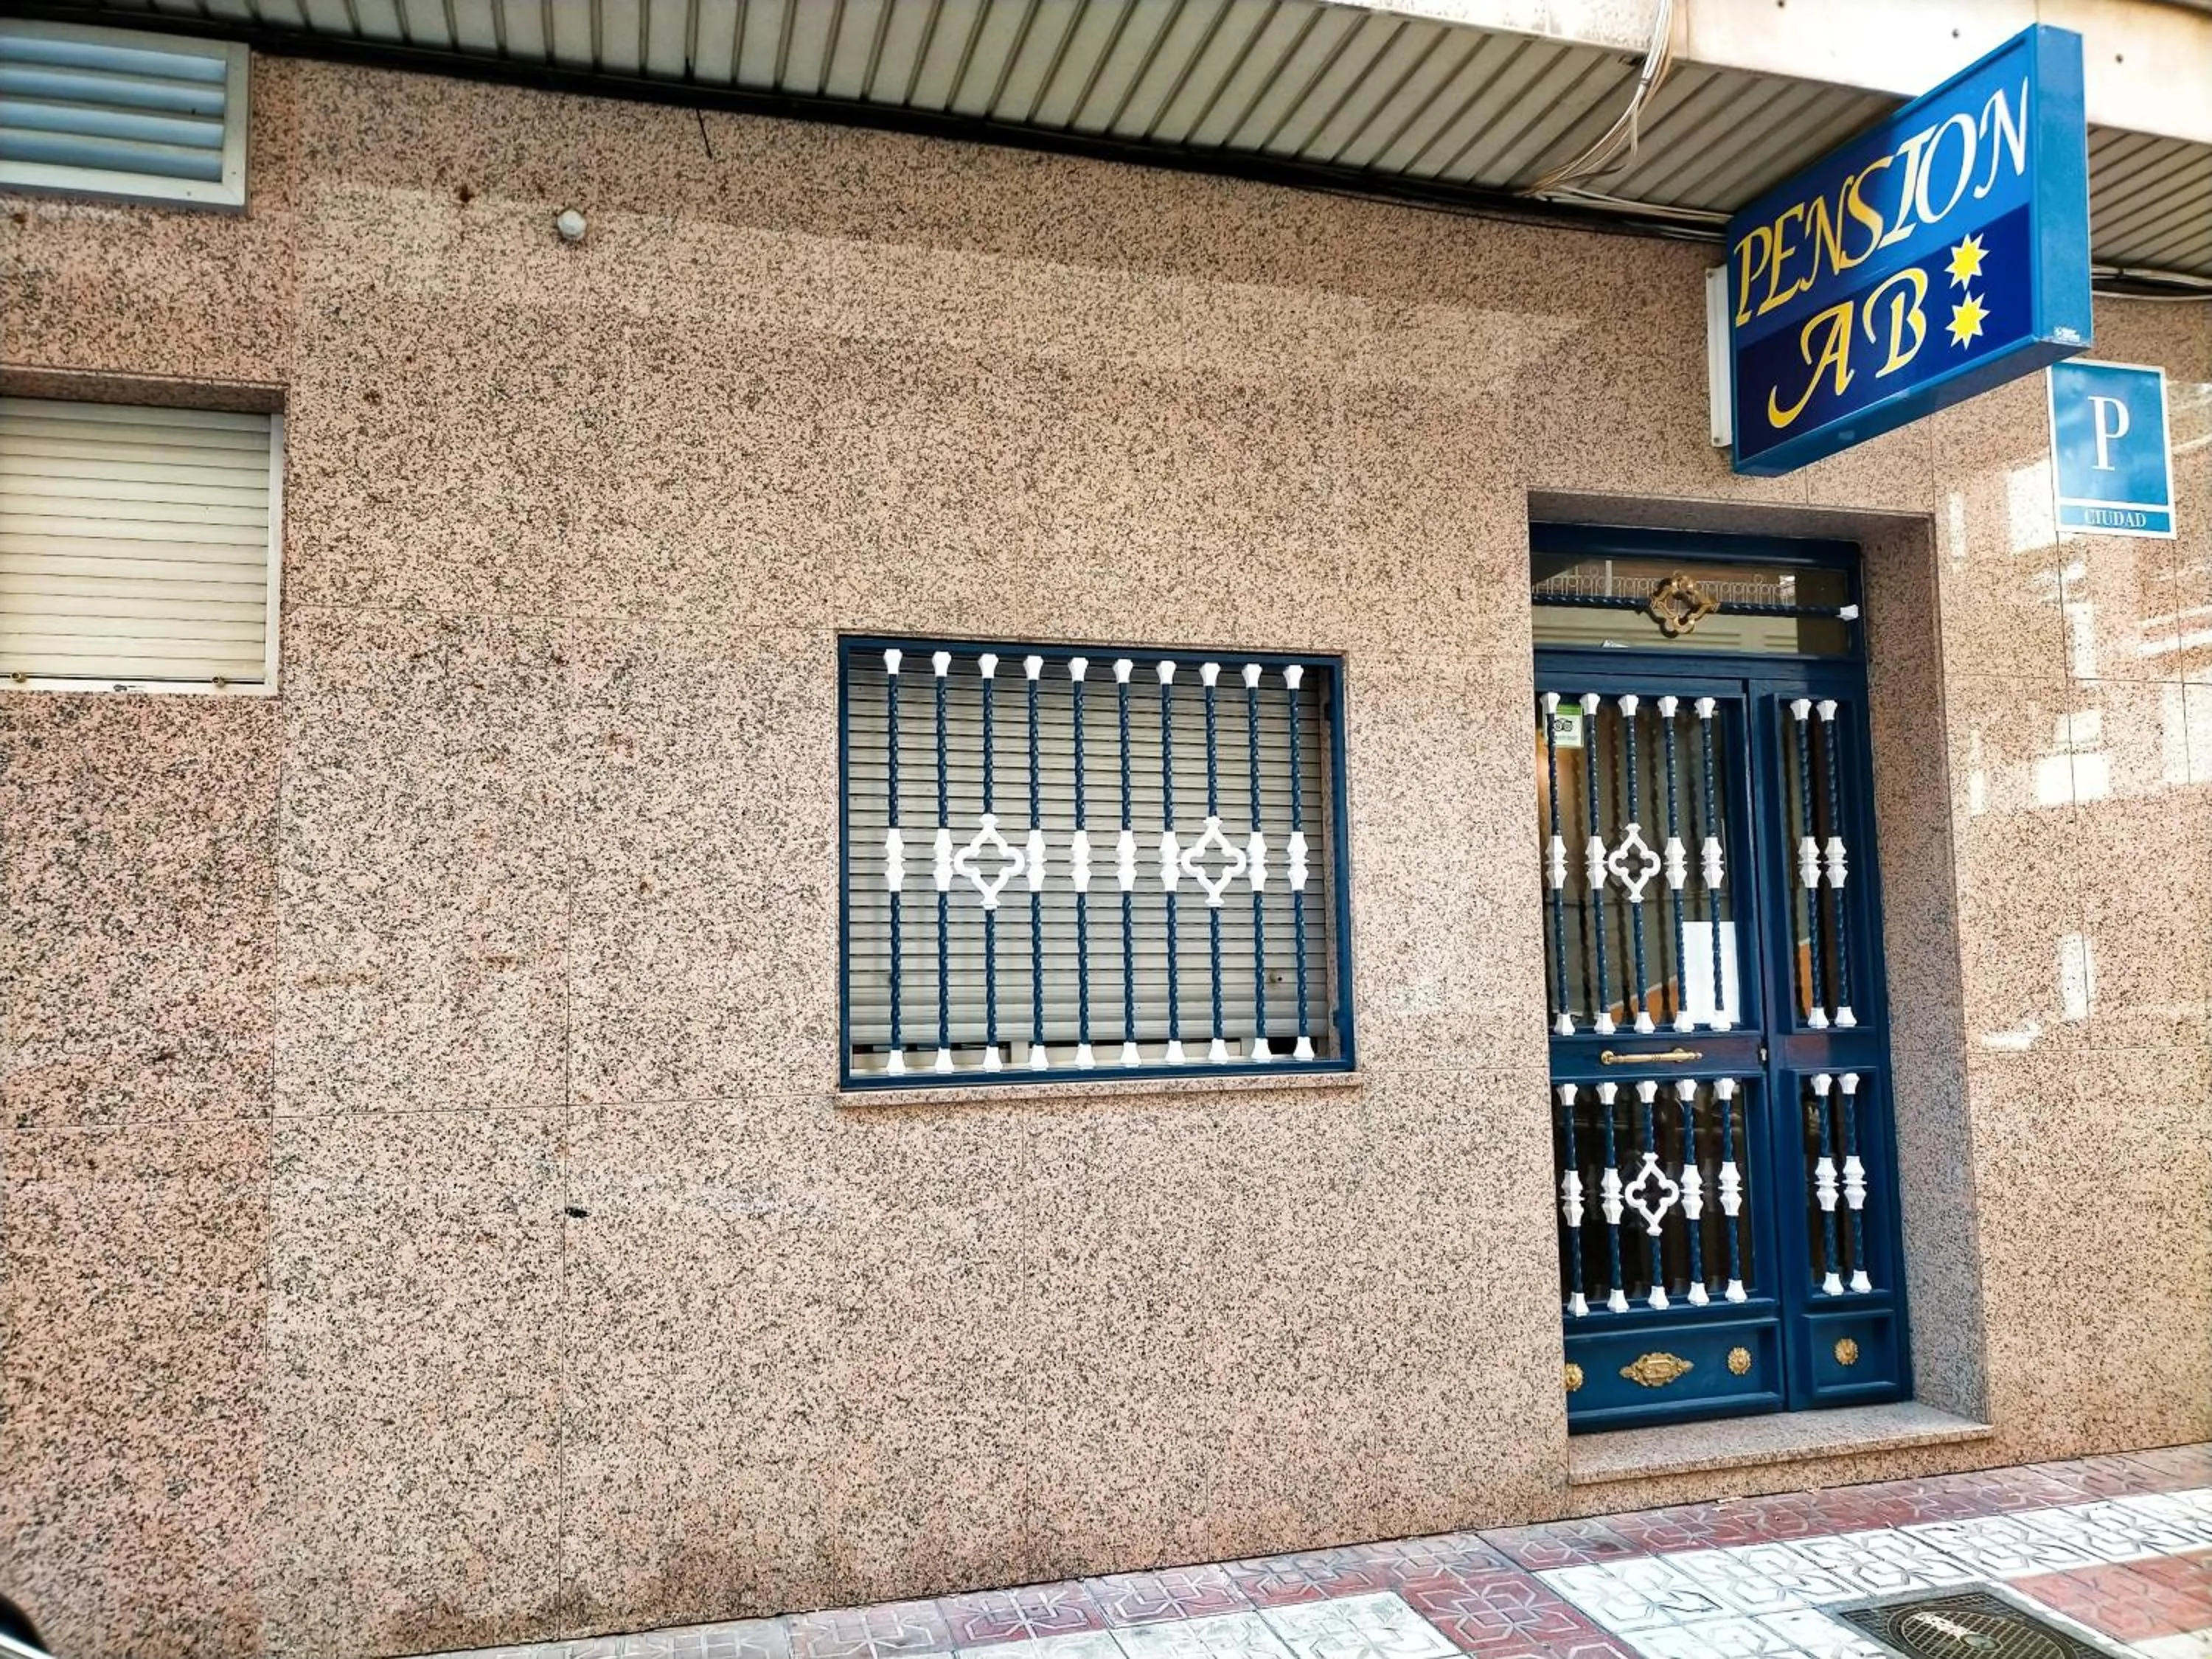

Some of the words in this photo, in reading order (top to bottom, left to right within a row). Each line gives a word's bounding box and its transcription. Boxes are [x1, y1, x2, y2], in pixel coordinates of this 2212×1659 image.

[1733, 76, 2028, 327] PENSION
[1768, 267, 1928, 428] AB
[2087, 396, 2130, 470] P
[2084, 509, 2146, 527] CIUDAD
